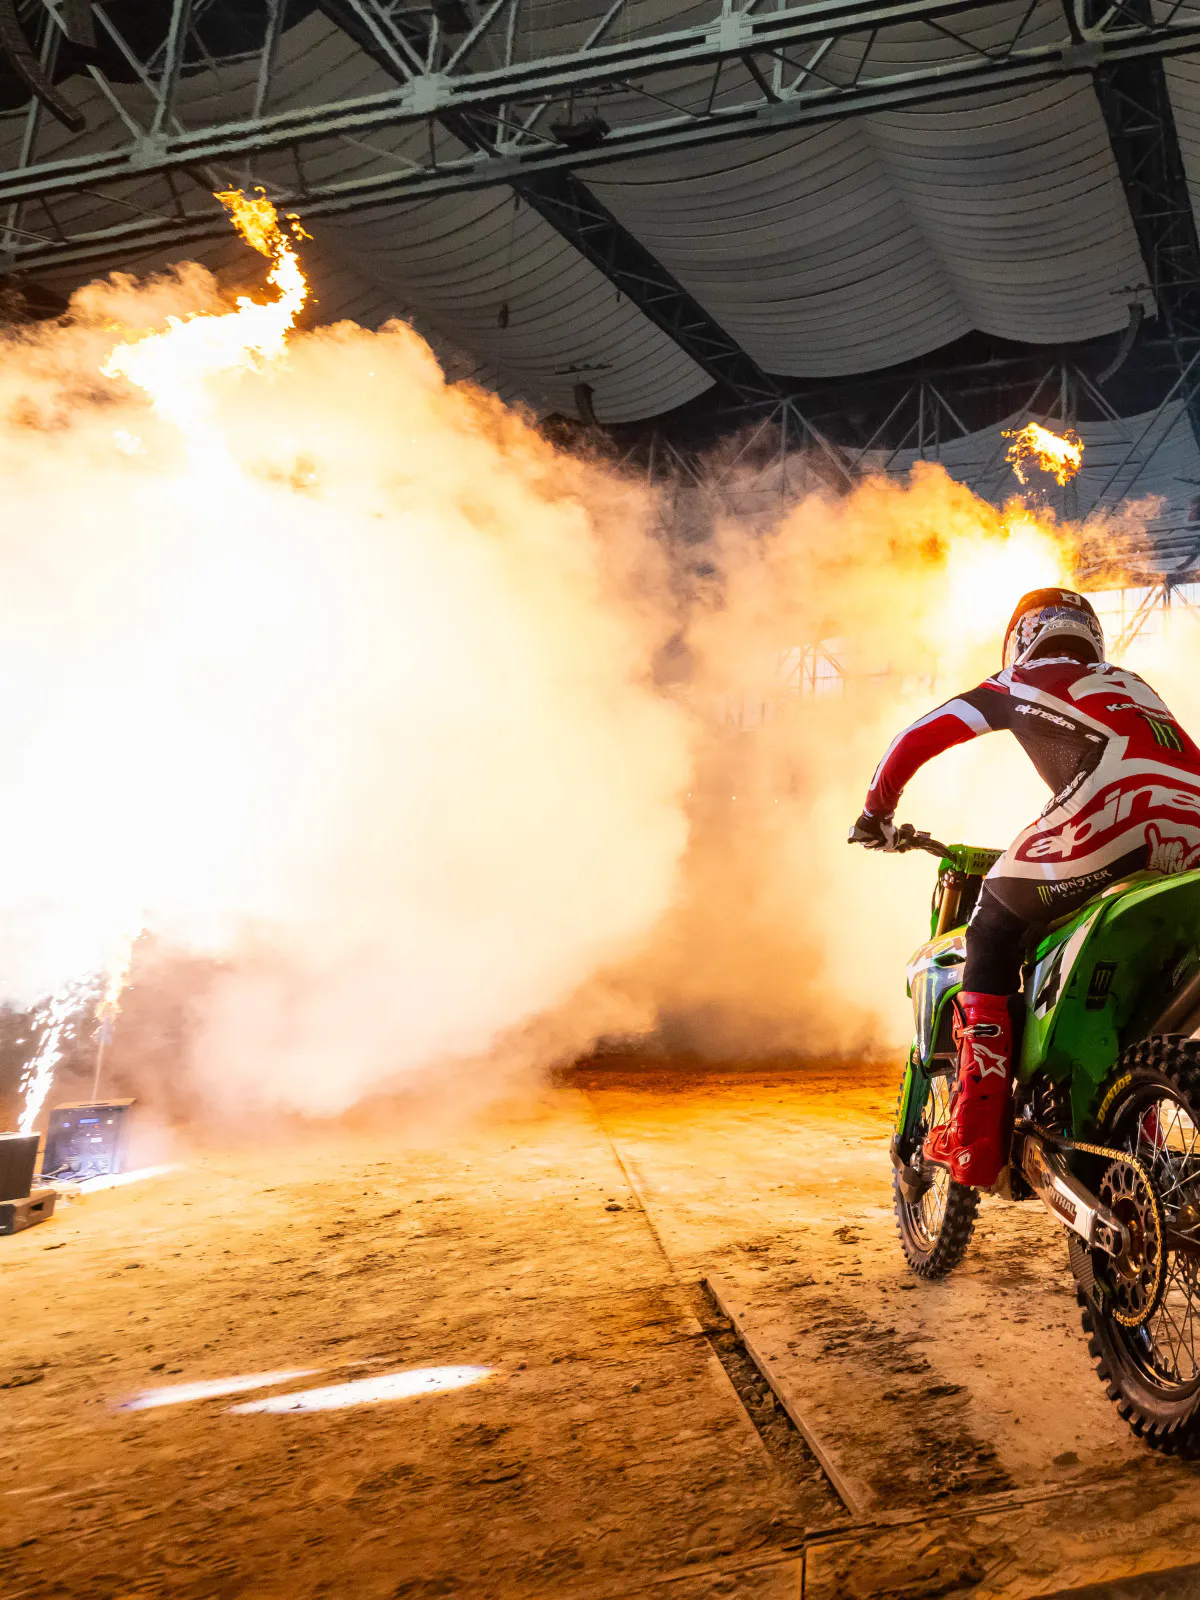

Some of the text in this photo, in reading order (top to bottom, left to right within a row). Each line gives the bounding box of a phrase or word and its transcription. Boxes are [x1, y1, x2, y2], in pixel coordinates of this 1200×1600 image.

[1015, 704, 1076, 731] alpinestars
[1050, 870, 1113, 893] MONSTER
[1097, 1074, 1132, 1124] DUNLOP
